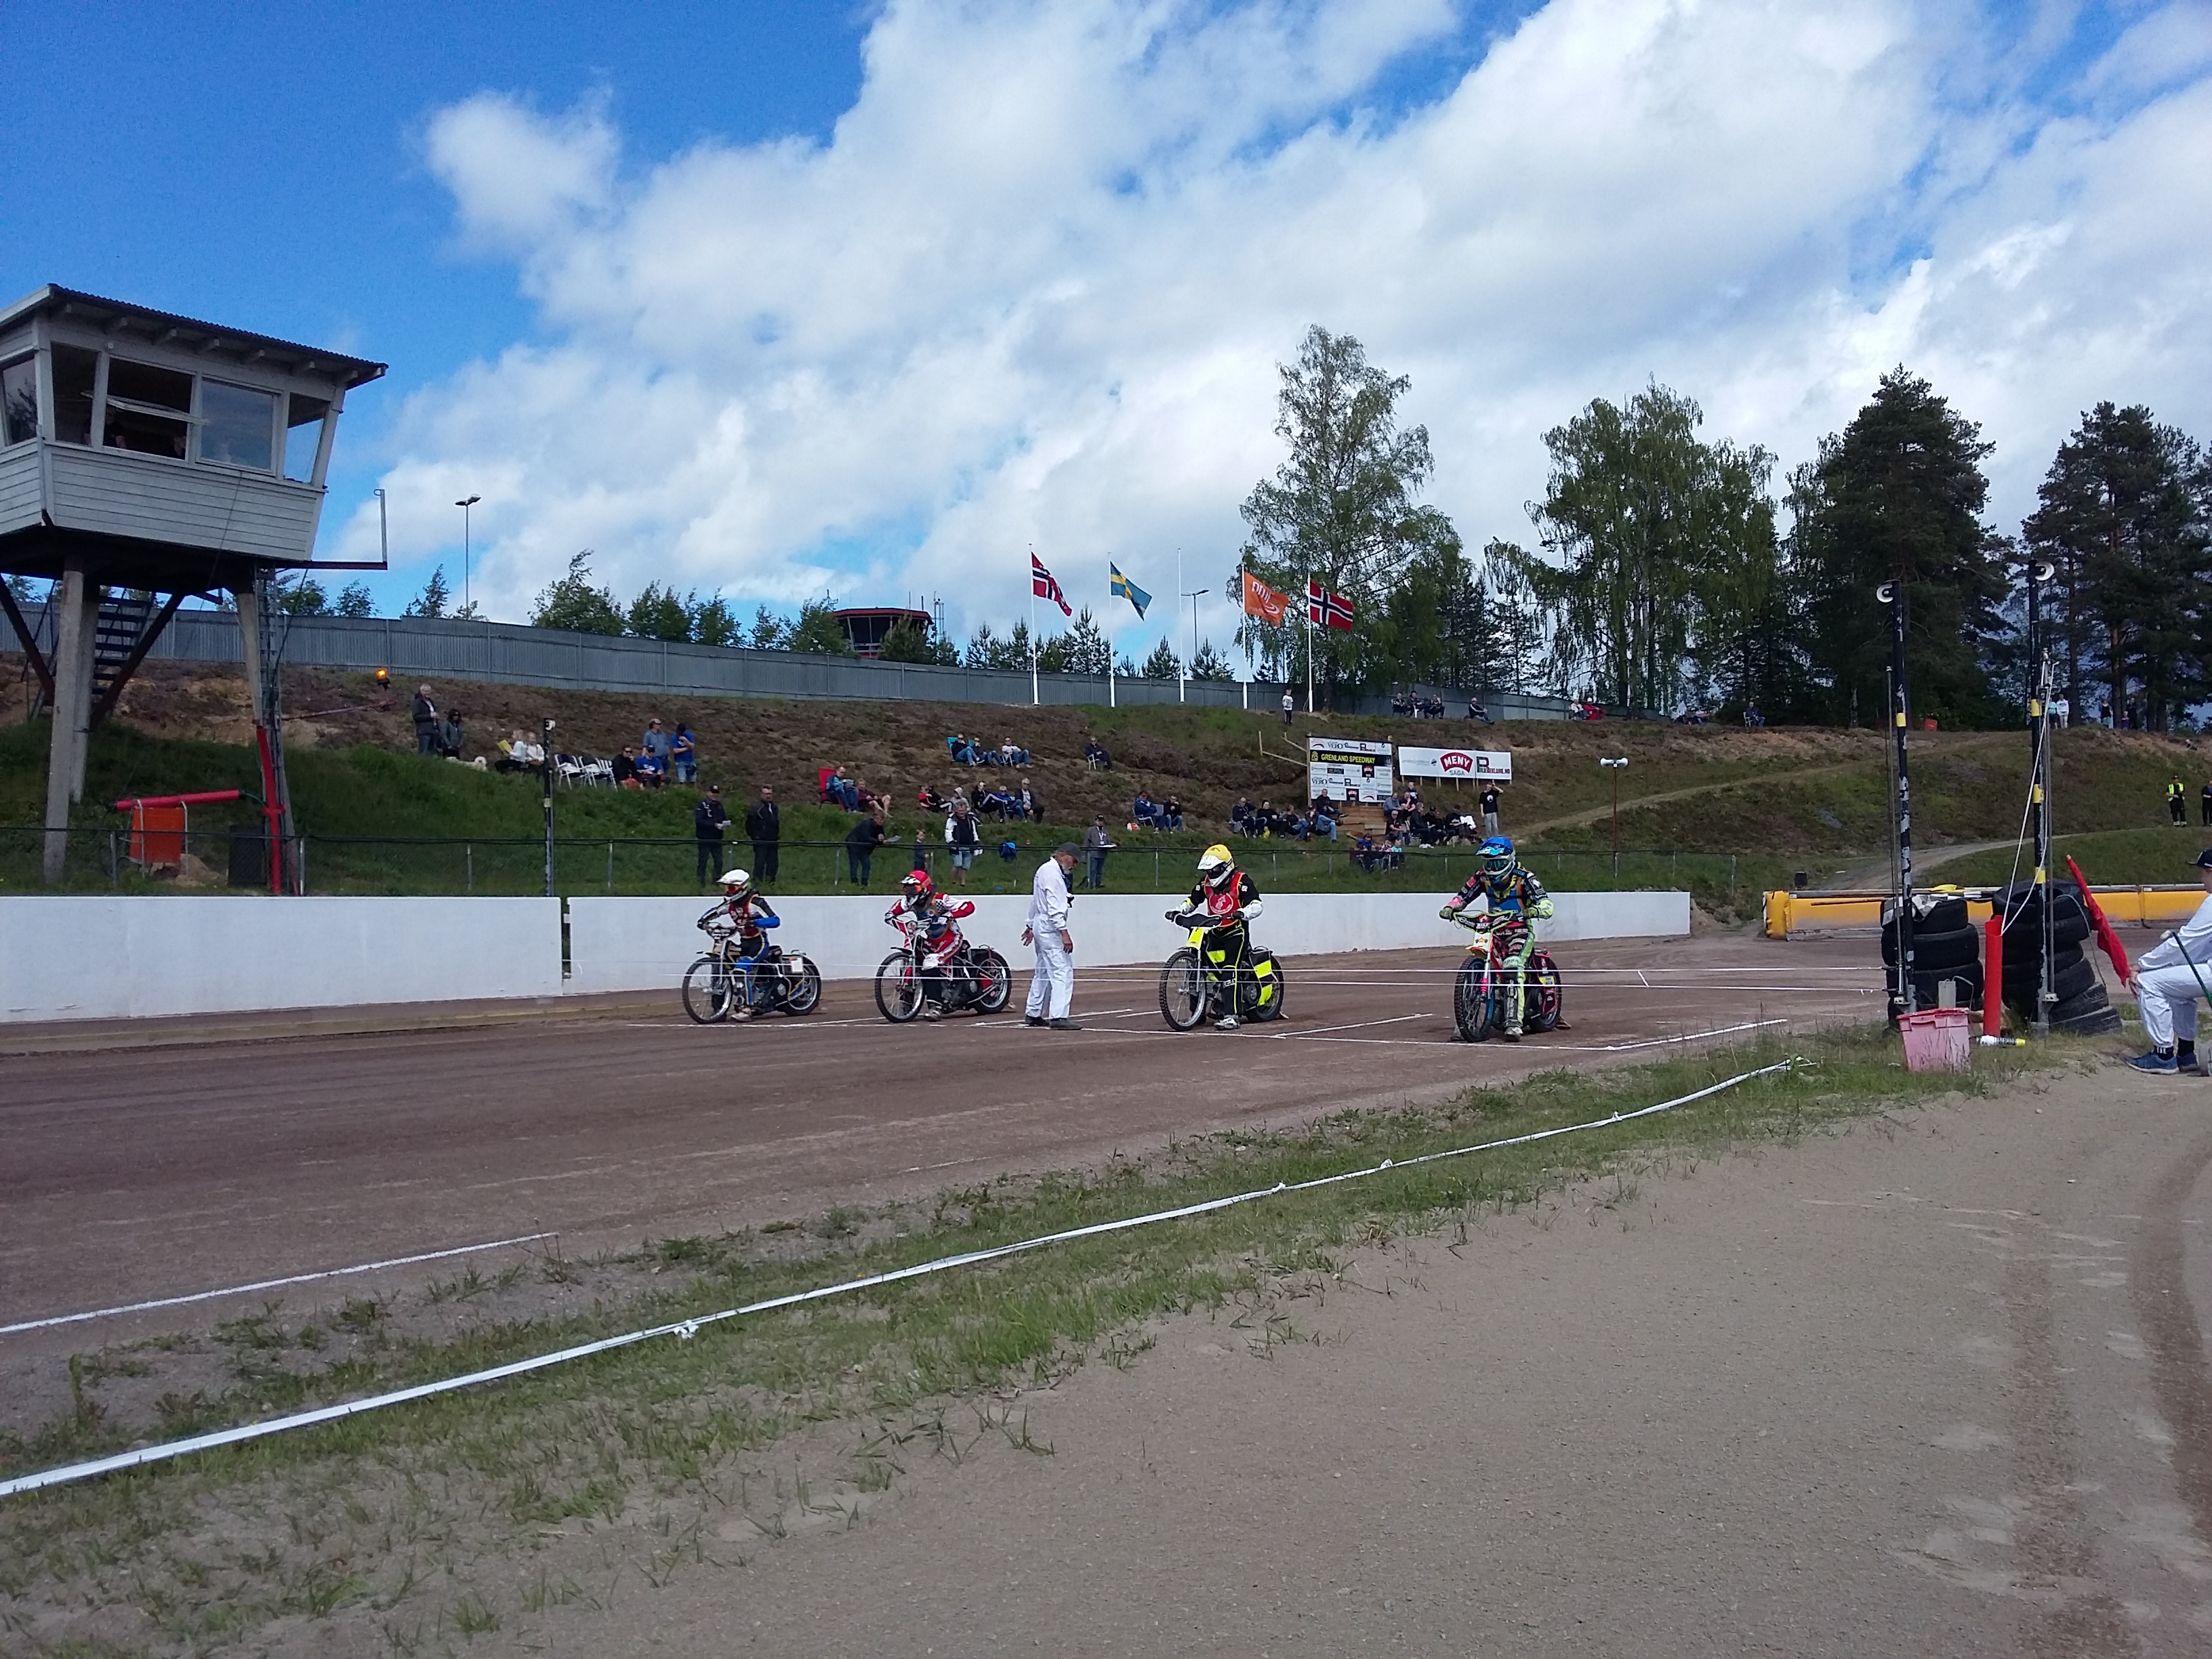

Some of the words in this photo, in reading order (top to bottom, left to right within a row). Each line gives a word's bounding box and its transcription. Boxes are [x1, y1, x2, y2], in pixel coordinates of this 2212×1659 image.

[1322, 754, 1348, 762] GRENLAND
[1349, 756, 1375, 764] SPEEDWAY
[1444, 756, 1470, 767] MENY
